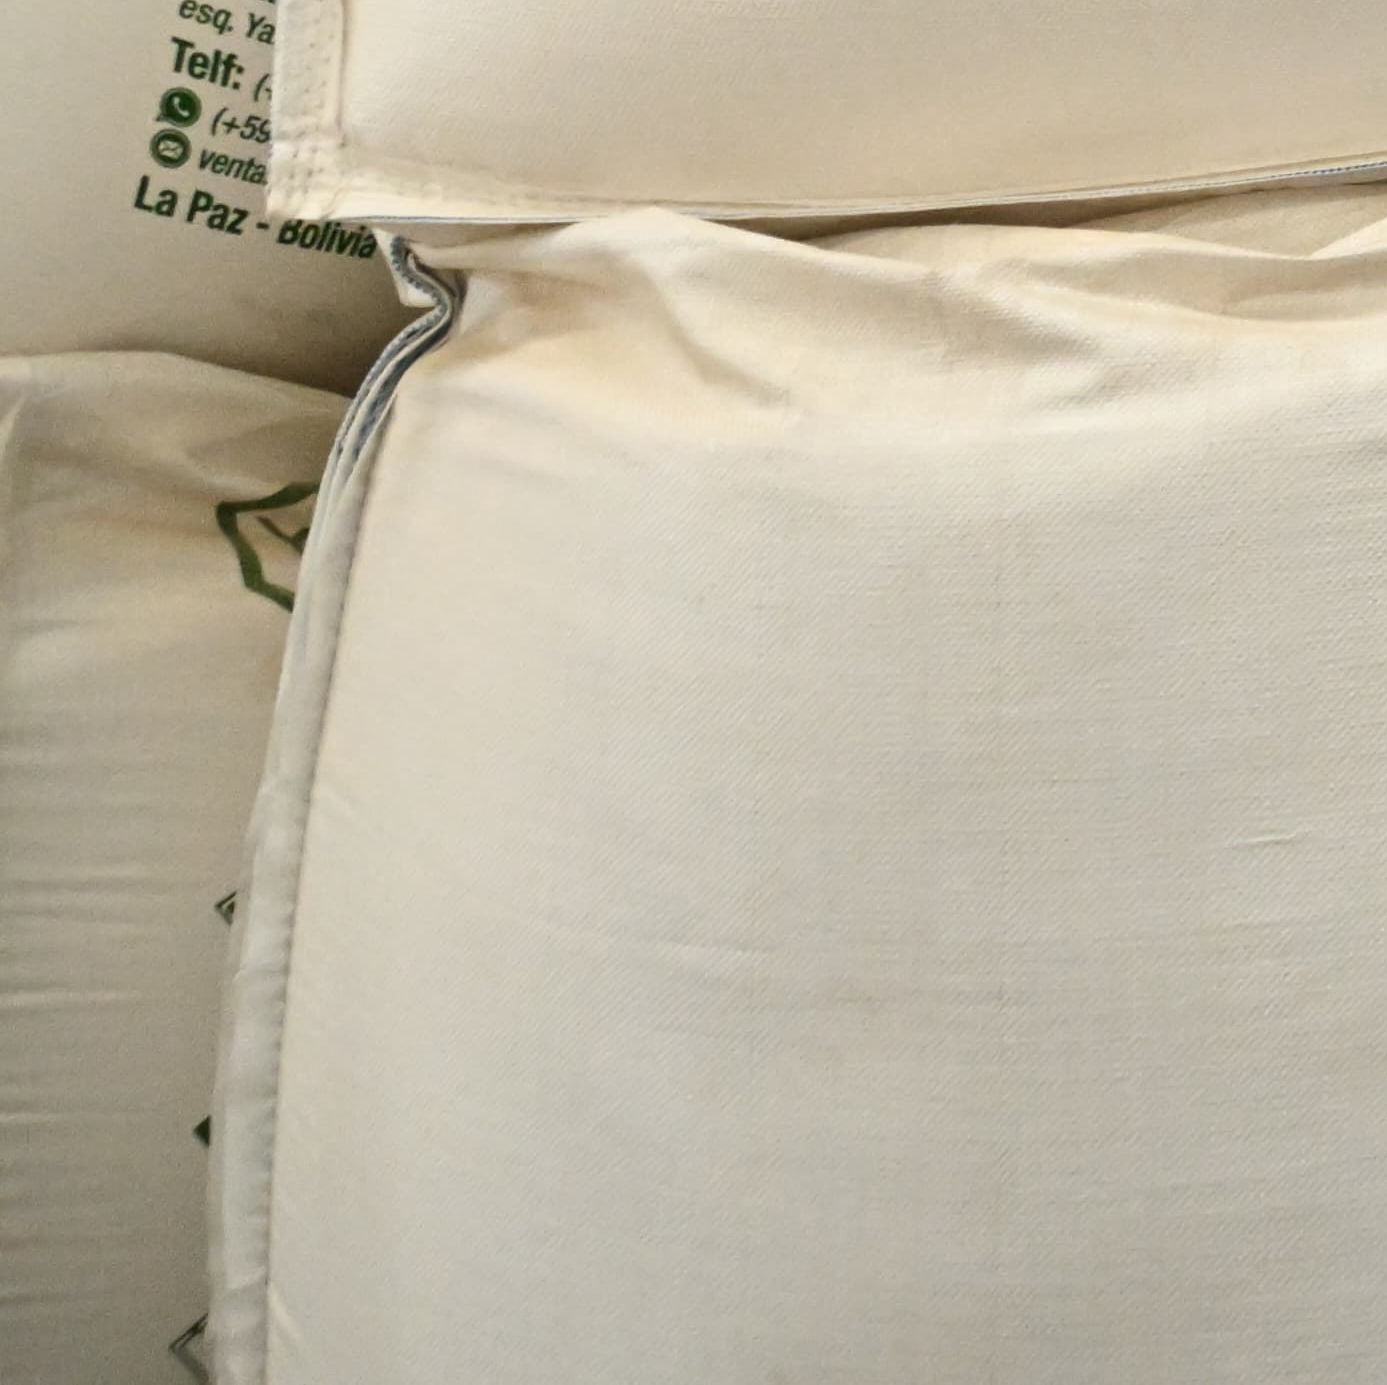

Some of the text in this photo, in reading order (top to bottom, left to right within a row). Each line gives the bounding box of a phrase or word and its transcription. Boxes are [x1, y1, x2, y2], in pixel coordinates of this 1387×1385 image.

[246, 13, 275, 45] Ya
[171, 36, 245, 90] Telf:
[198, 148, 269, 185] venta
[134, 175, 178, 216] La
[186, 189, 249, 235] Paz
[278, 219, 378, 258] Bolivia
